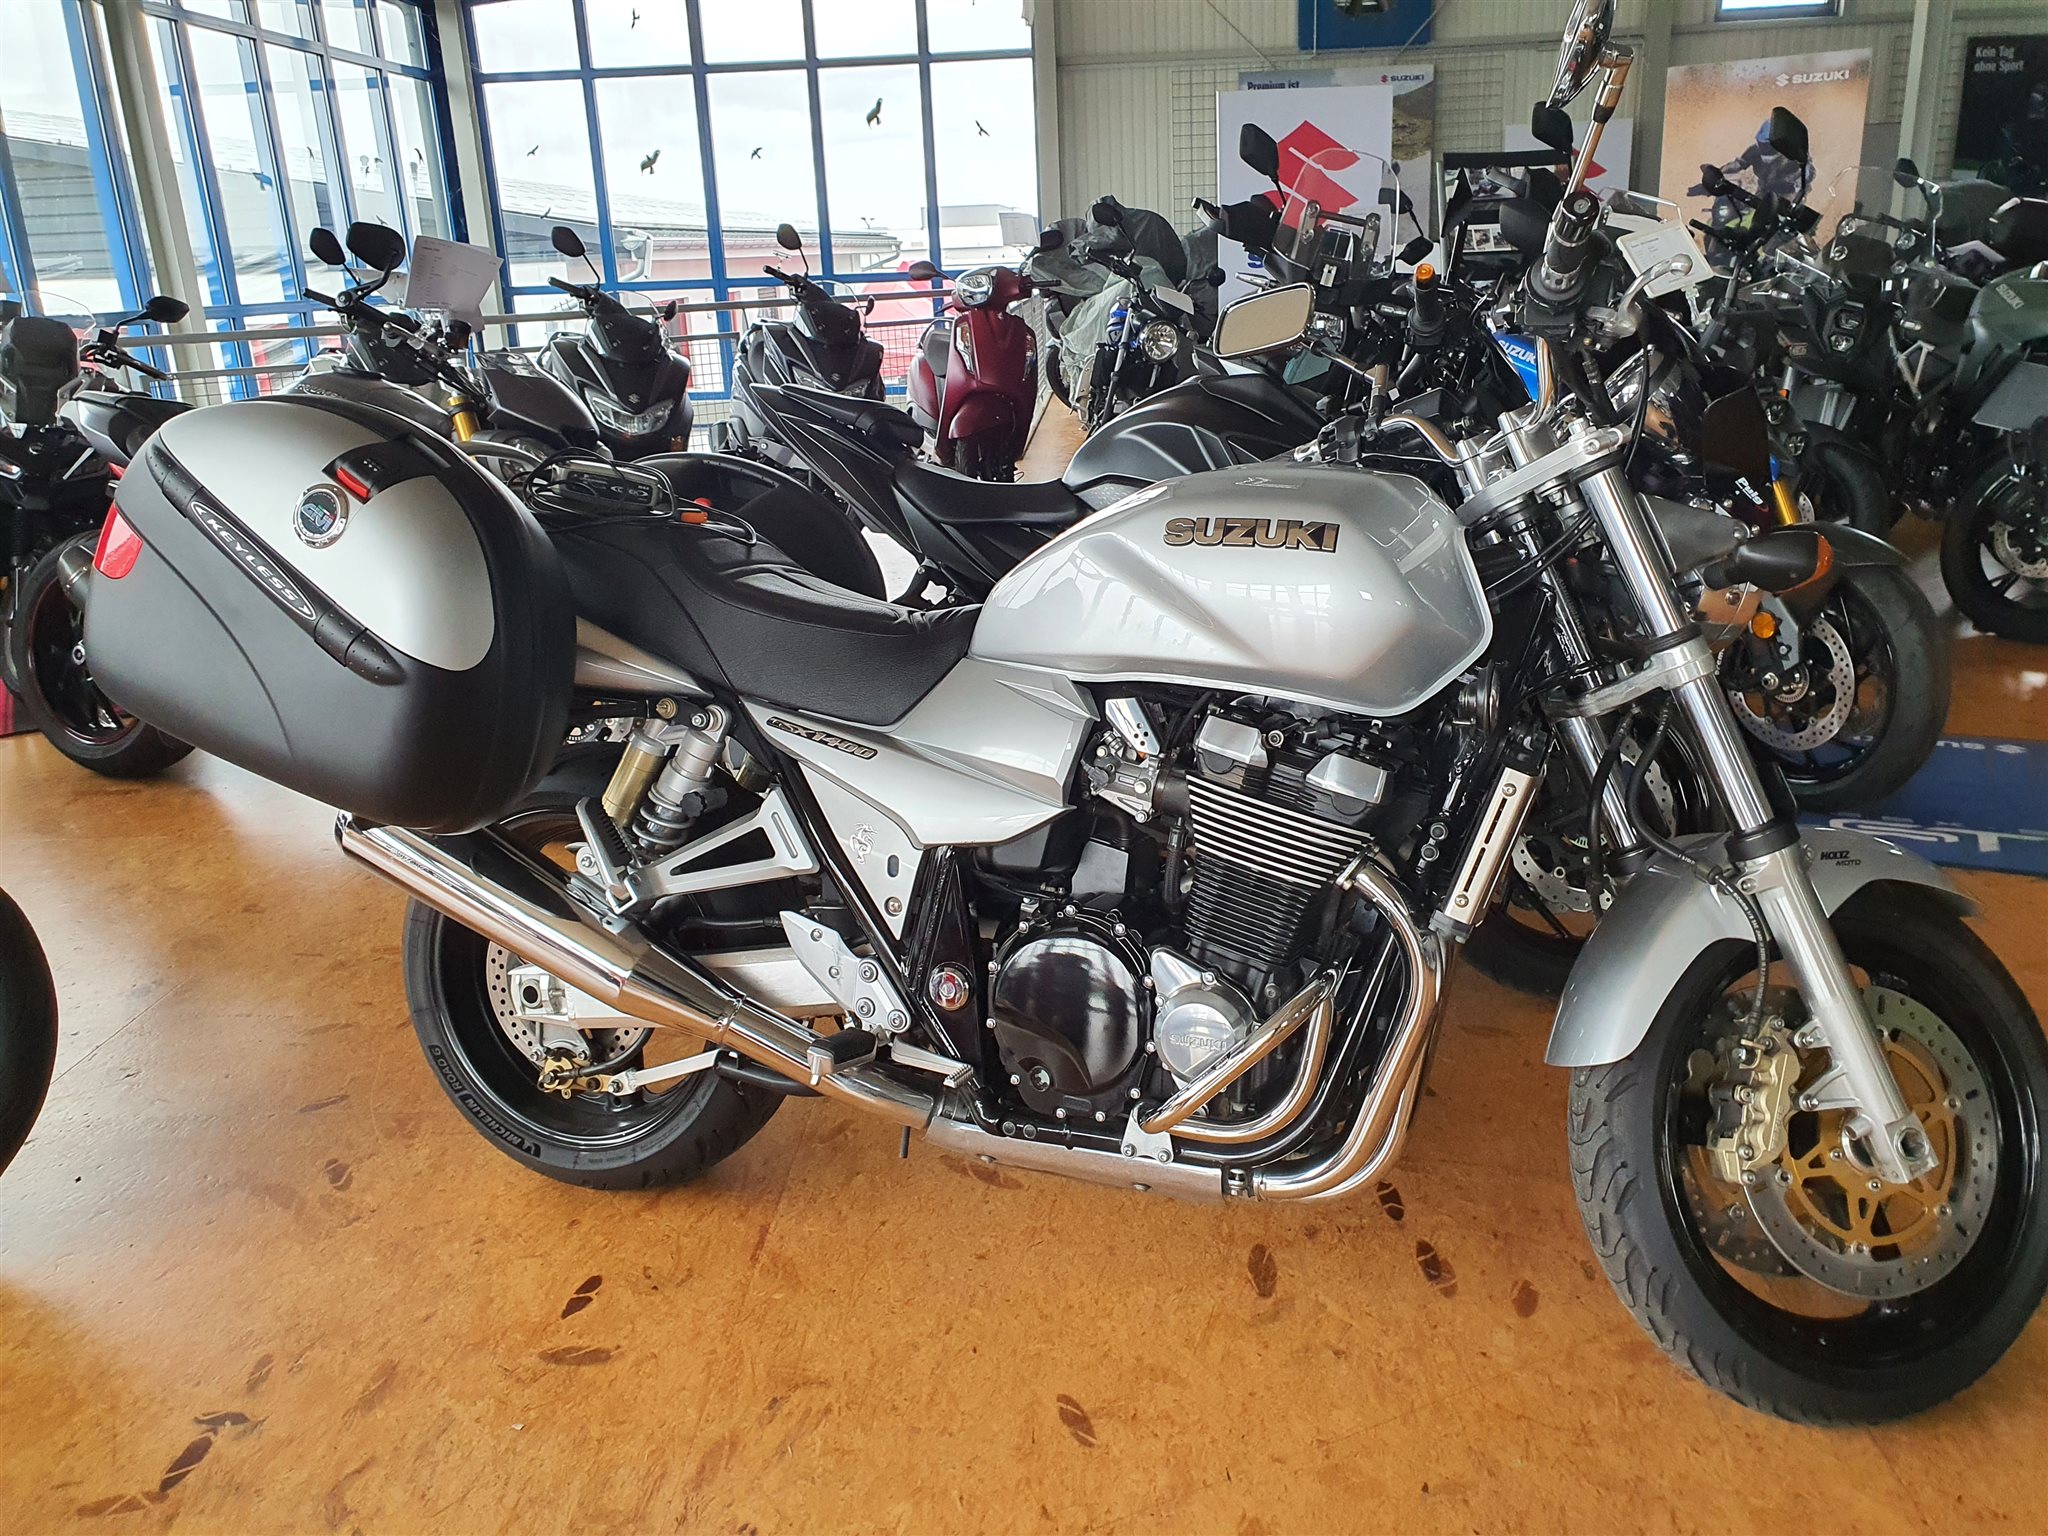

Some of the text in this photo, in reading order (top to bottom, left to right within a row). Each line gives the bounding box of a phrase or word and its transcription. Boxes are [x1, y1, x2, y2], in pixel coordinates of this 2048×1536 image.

[1976, 45, 2014, 59] Kein Tag
[1390, 74, 1425, 82] SUZUKI
[1791, 70, 1850, 84] SUZUKI
[1974, 60, 2024, 73] ohne Sport
[1996, 283, 2024, 310] SUZUKI
[1498, 340, 1535, 365] SUZUK
[1163, 517, 1340, 553] SUZUKI
[206, 518, 299, 601] KEYLESS
[437, 1059, 463, 1091] ROAD
[464, 1097, 523, 1146] MICHELIN
